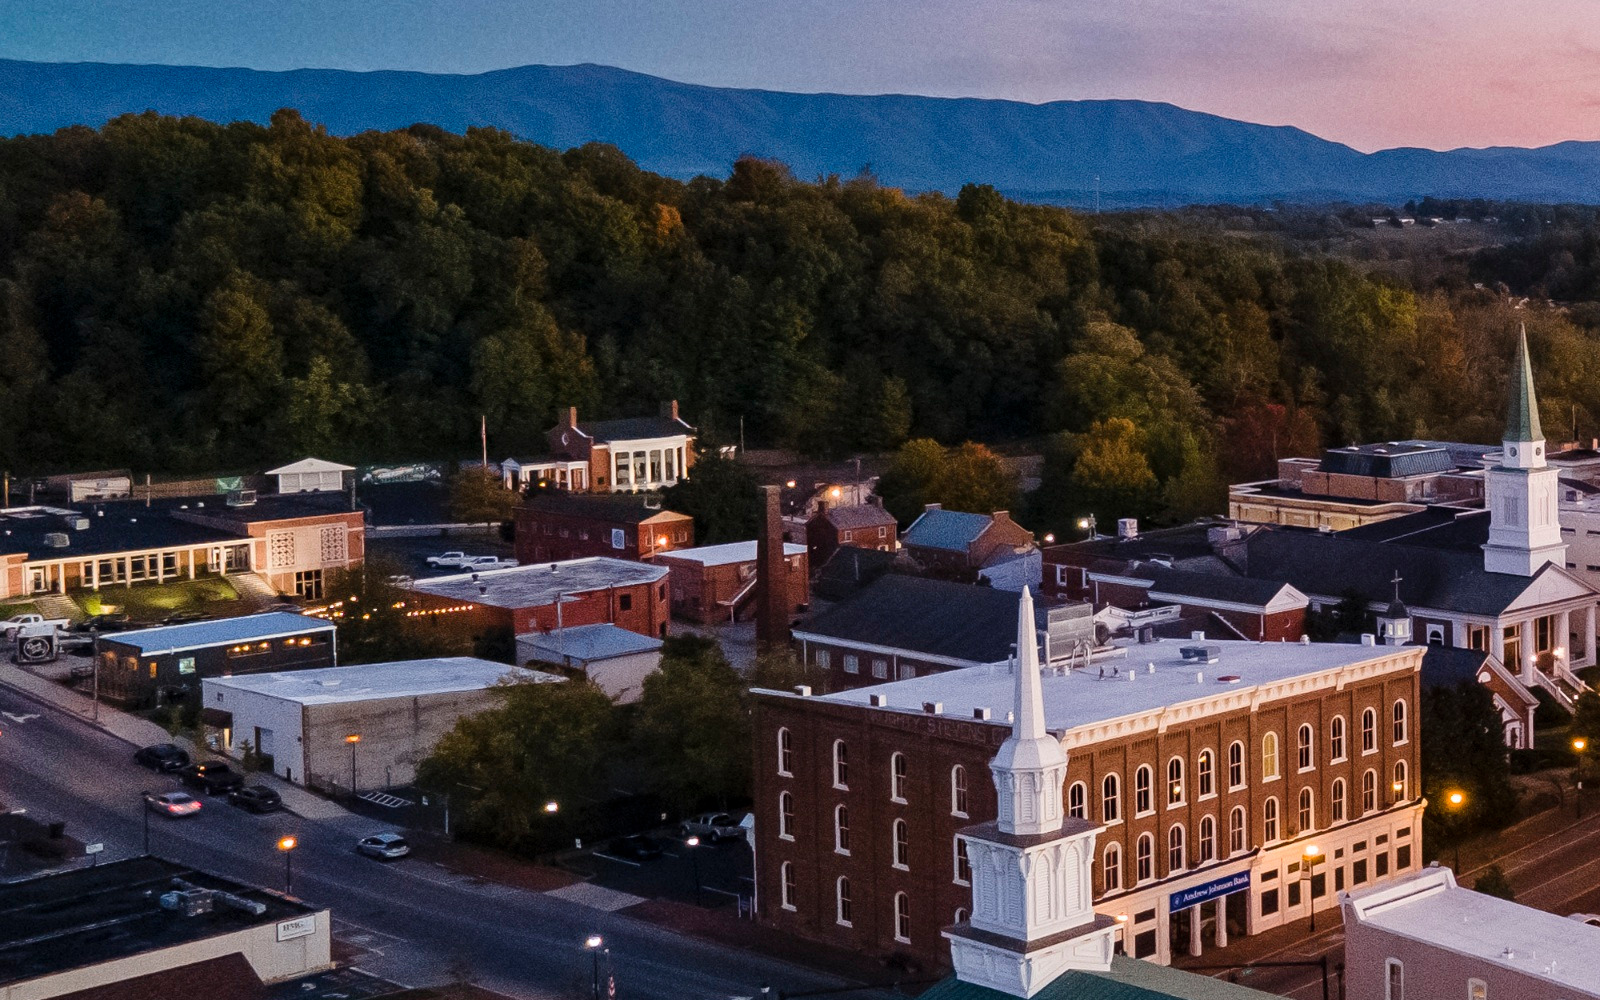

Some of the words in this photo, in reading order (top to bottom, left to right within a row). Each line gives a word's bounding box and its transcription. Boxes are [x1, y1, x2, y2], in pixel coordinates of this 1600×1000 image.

[1183, 890, 1208, 902] Andrew
[1208, 882, 1233, 895] Johnson
[1233, 874, 1249, 886] Bank
